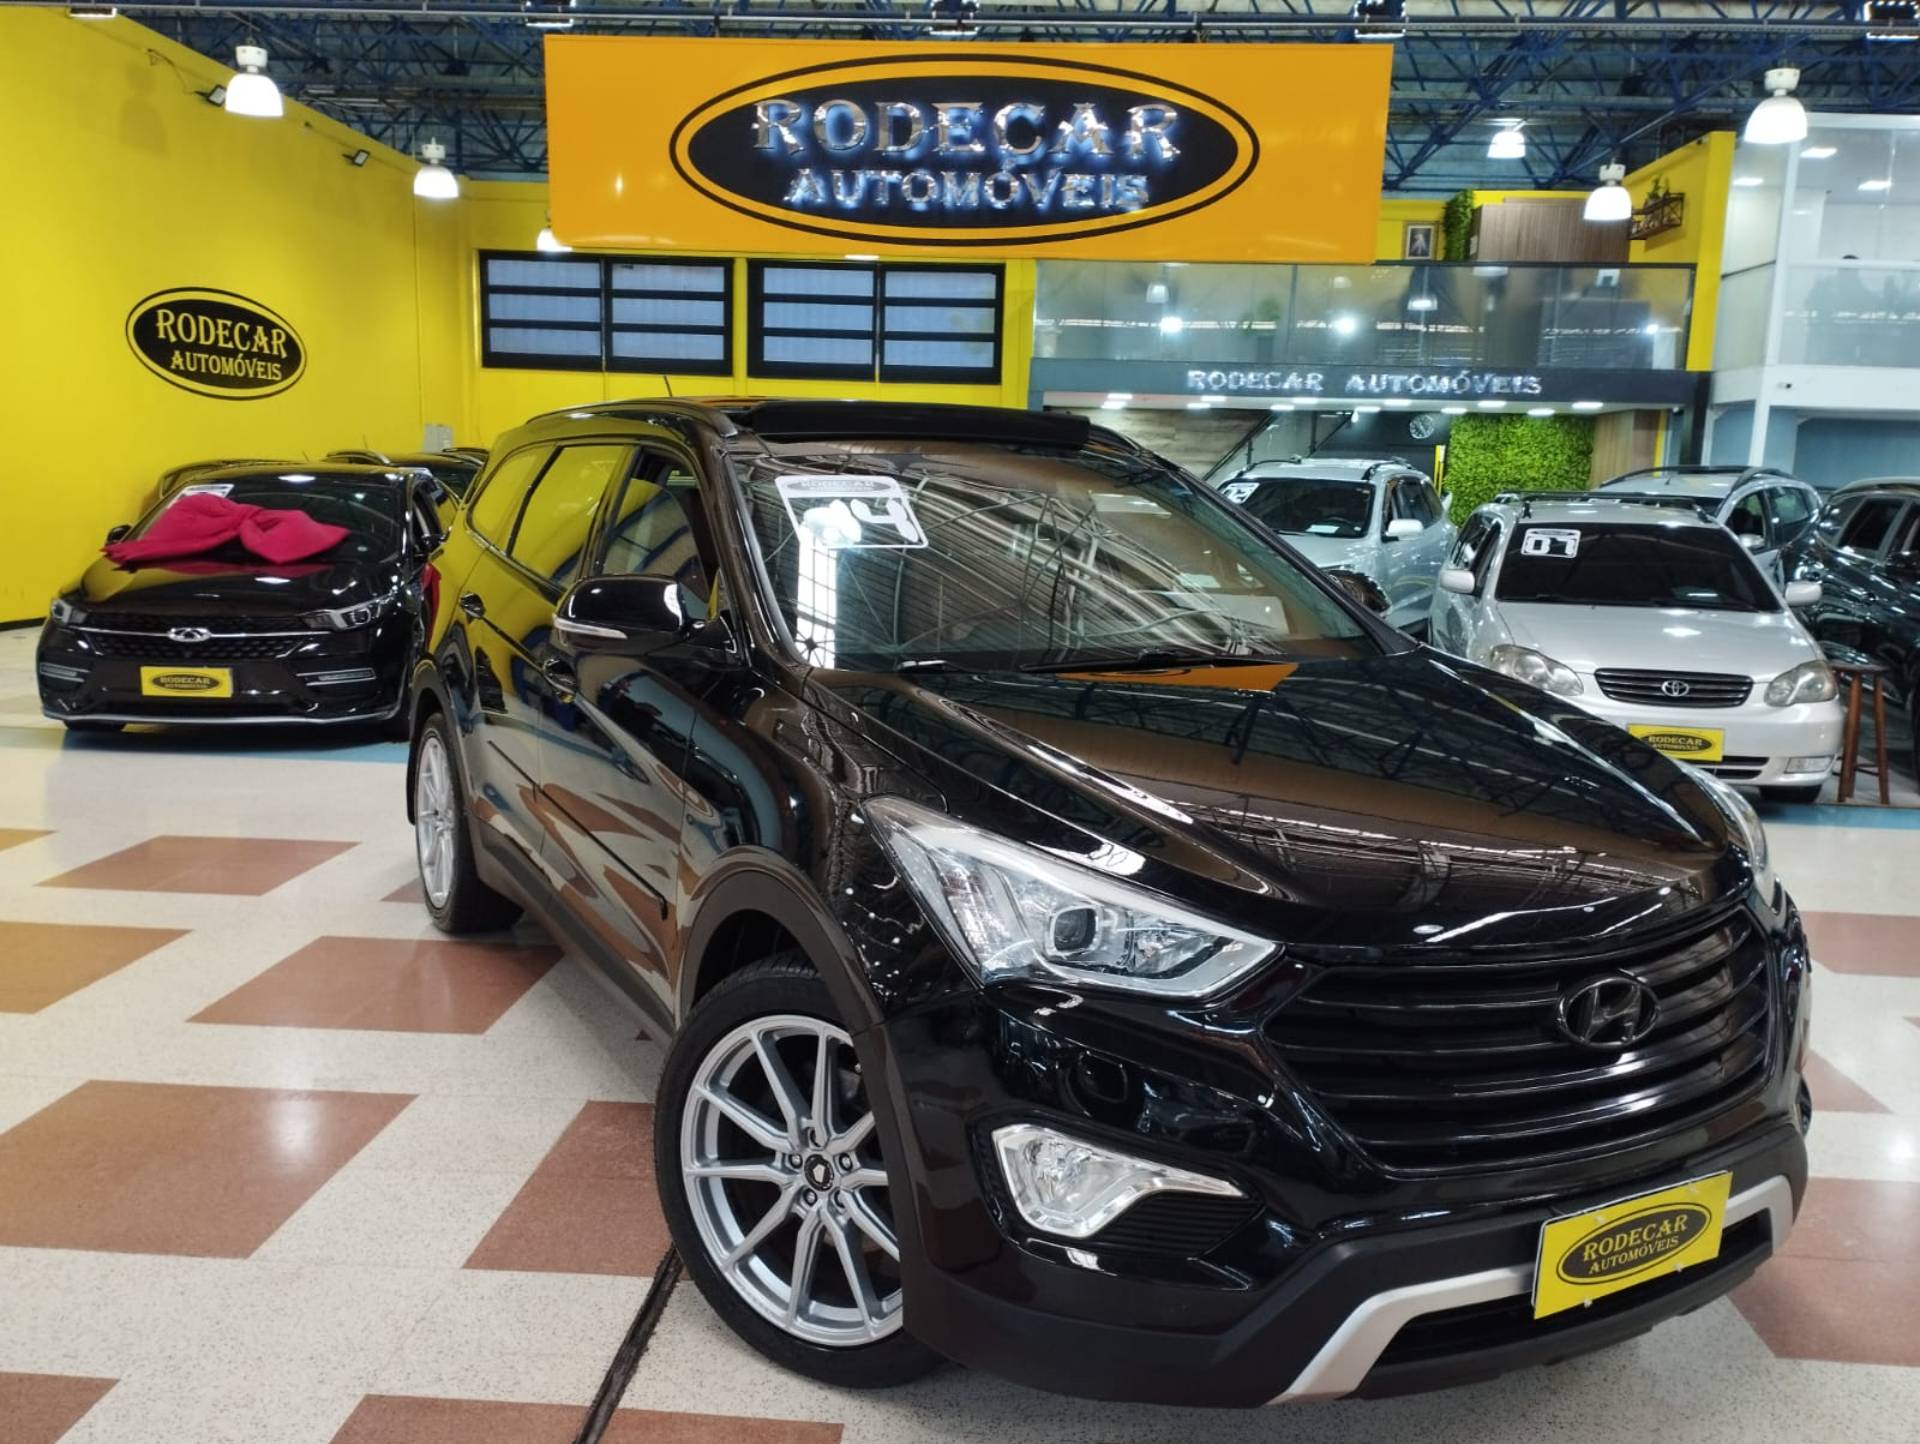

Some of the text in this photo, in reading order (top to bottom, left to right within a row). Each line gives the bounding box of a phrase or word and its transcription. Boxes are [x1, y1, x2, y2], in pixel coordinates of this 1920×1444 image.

[752, 98, 1181, 160] RODECAR
[783, 157, 1149, 208] AUTOMÓVEIS
[156, 309, 287, 359] RODECAR
[170, 350, 282, 381] AUTOMÓVEIS
[1187, 370, 1543, 395] RODECAR AUTOMÓVEIS
[1582, 1213, 1688, 1263] RODECAR
[1588, 1235, 1680, 1275] AUTOMÓVEIS
